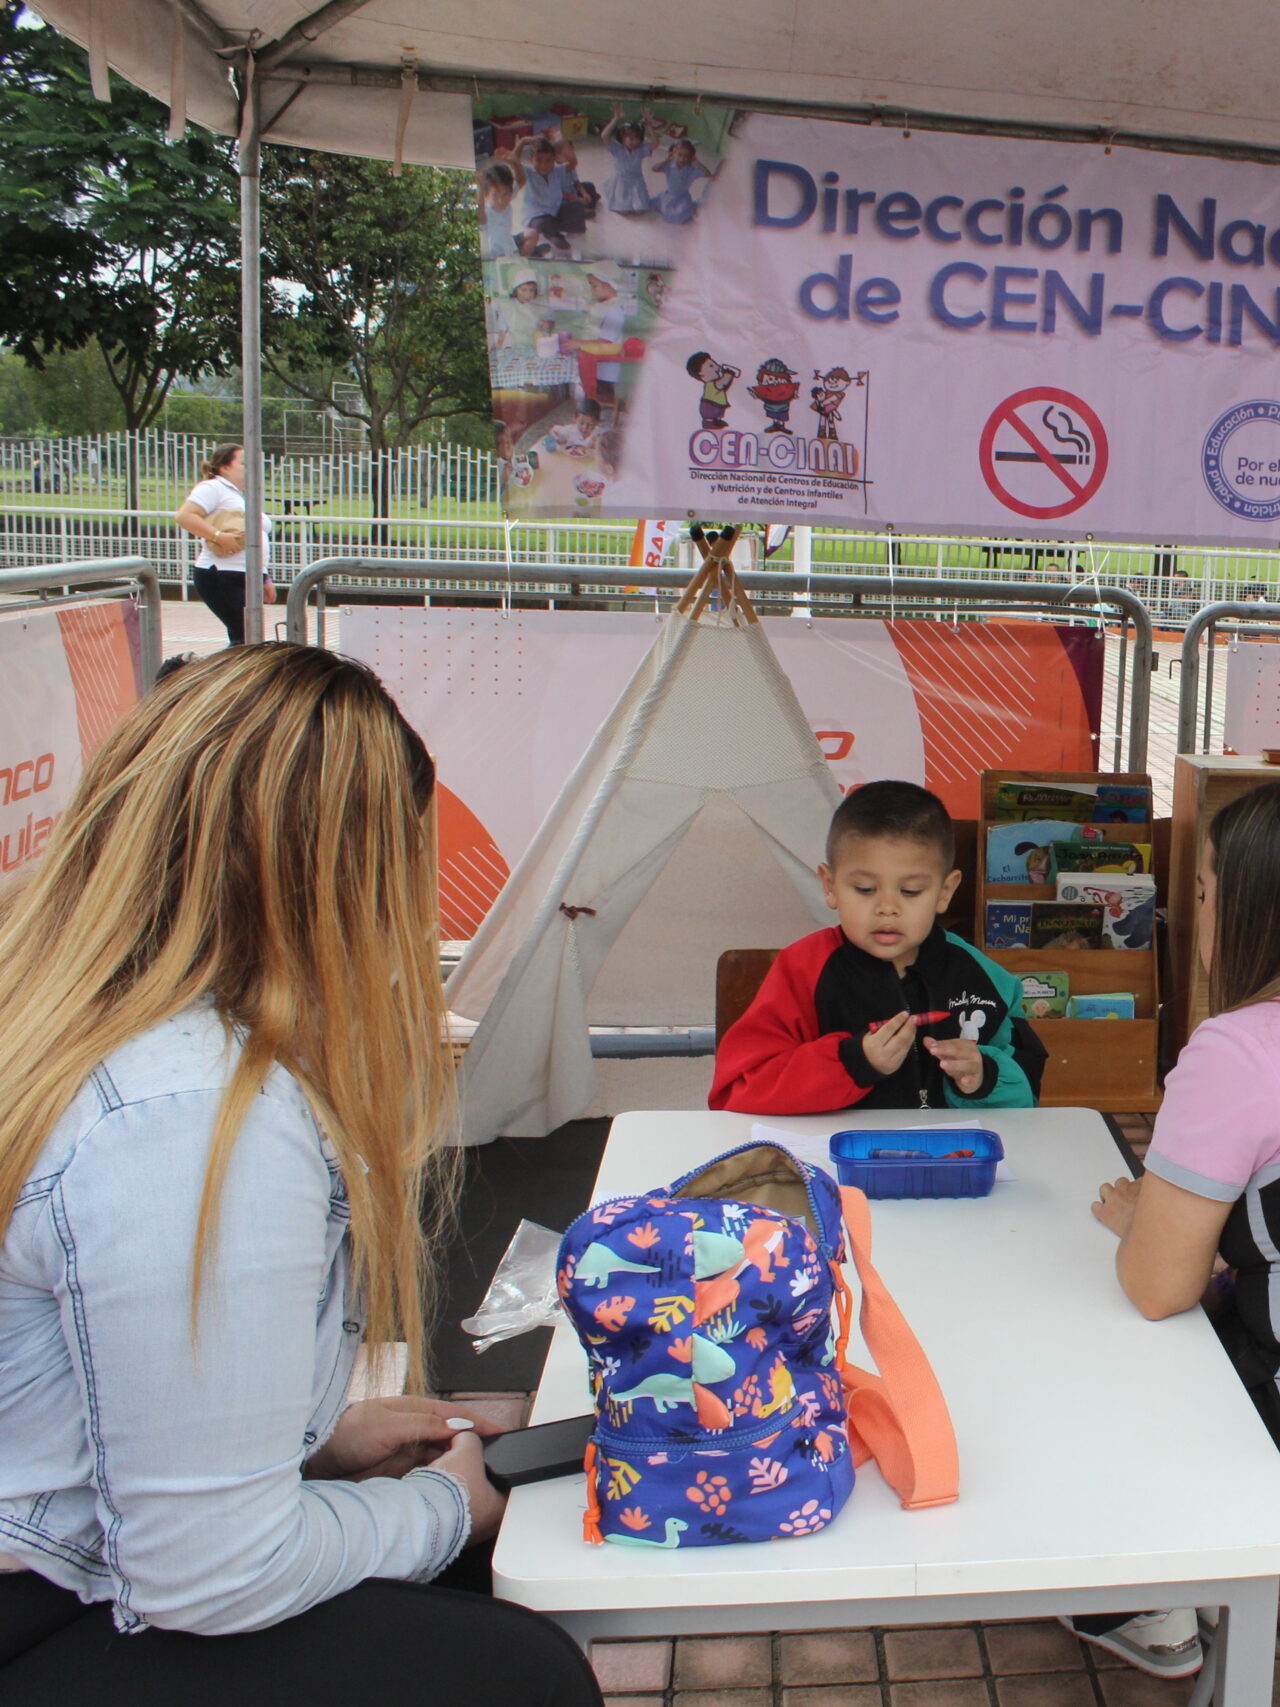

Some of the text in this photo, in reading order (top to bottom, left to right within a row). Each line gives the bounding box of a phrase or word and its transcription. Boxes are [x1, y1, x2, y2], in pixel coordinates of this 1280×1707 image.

[754, 158, 1124, 254] Dirección
[798, 253, 902, 325] de
[1206, 404, 1255, 457] Educación
[1237, 456, 1265, 471] Por
[1268, 458, 1280, 472] el
[690, 471, 860, 491] Dirección Nacional de Centros de Educación
[1206, 469, 1234, 504] Salud
[1235, 472, 1255, 486] de
[717, 483, 756, 494] Nutrición
[763, 485, 772, 495] de
[774, 486, 806, 497] Centros
[806, 488, 844, 500] Infantiles
[737, 495, 818, 509] de Atención Integral
[0, 811, 64, 873] ula
[1003, 914, 1017, 923] Mi
